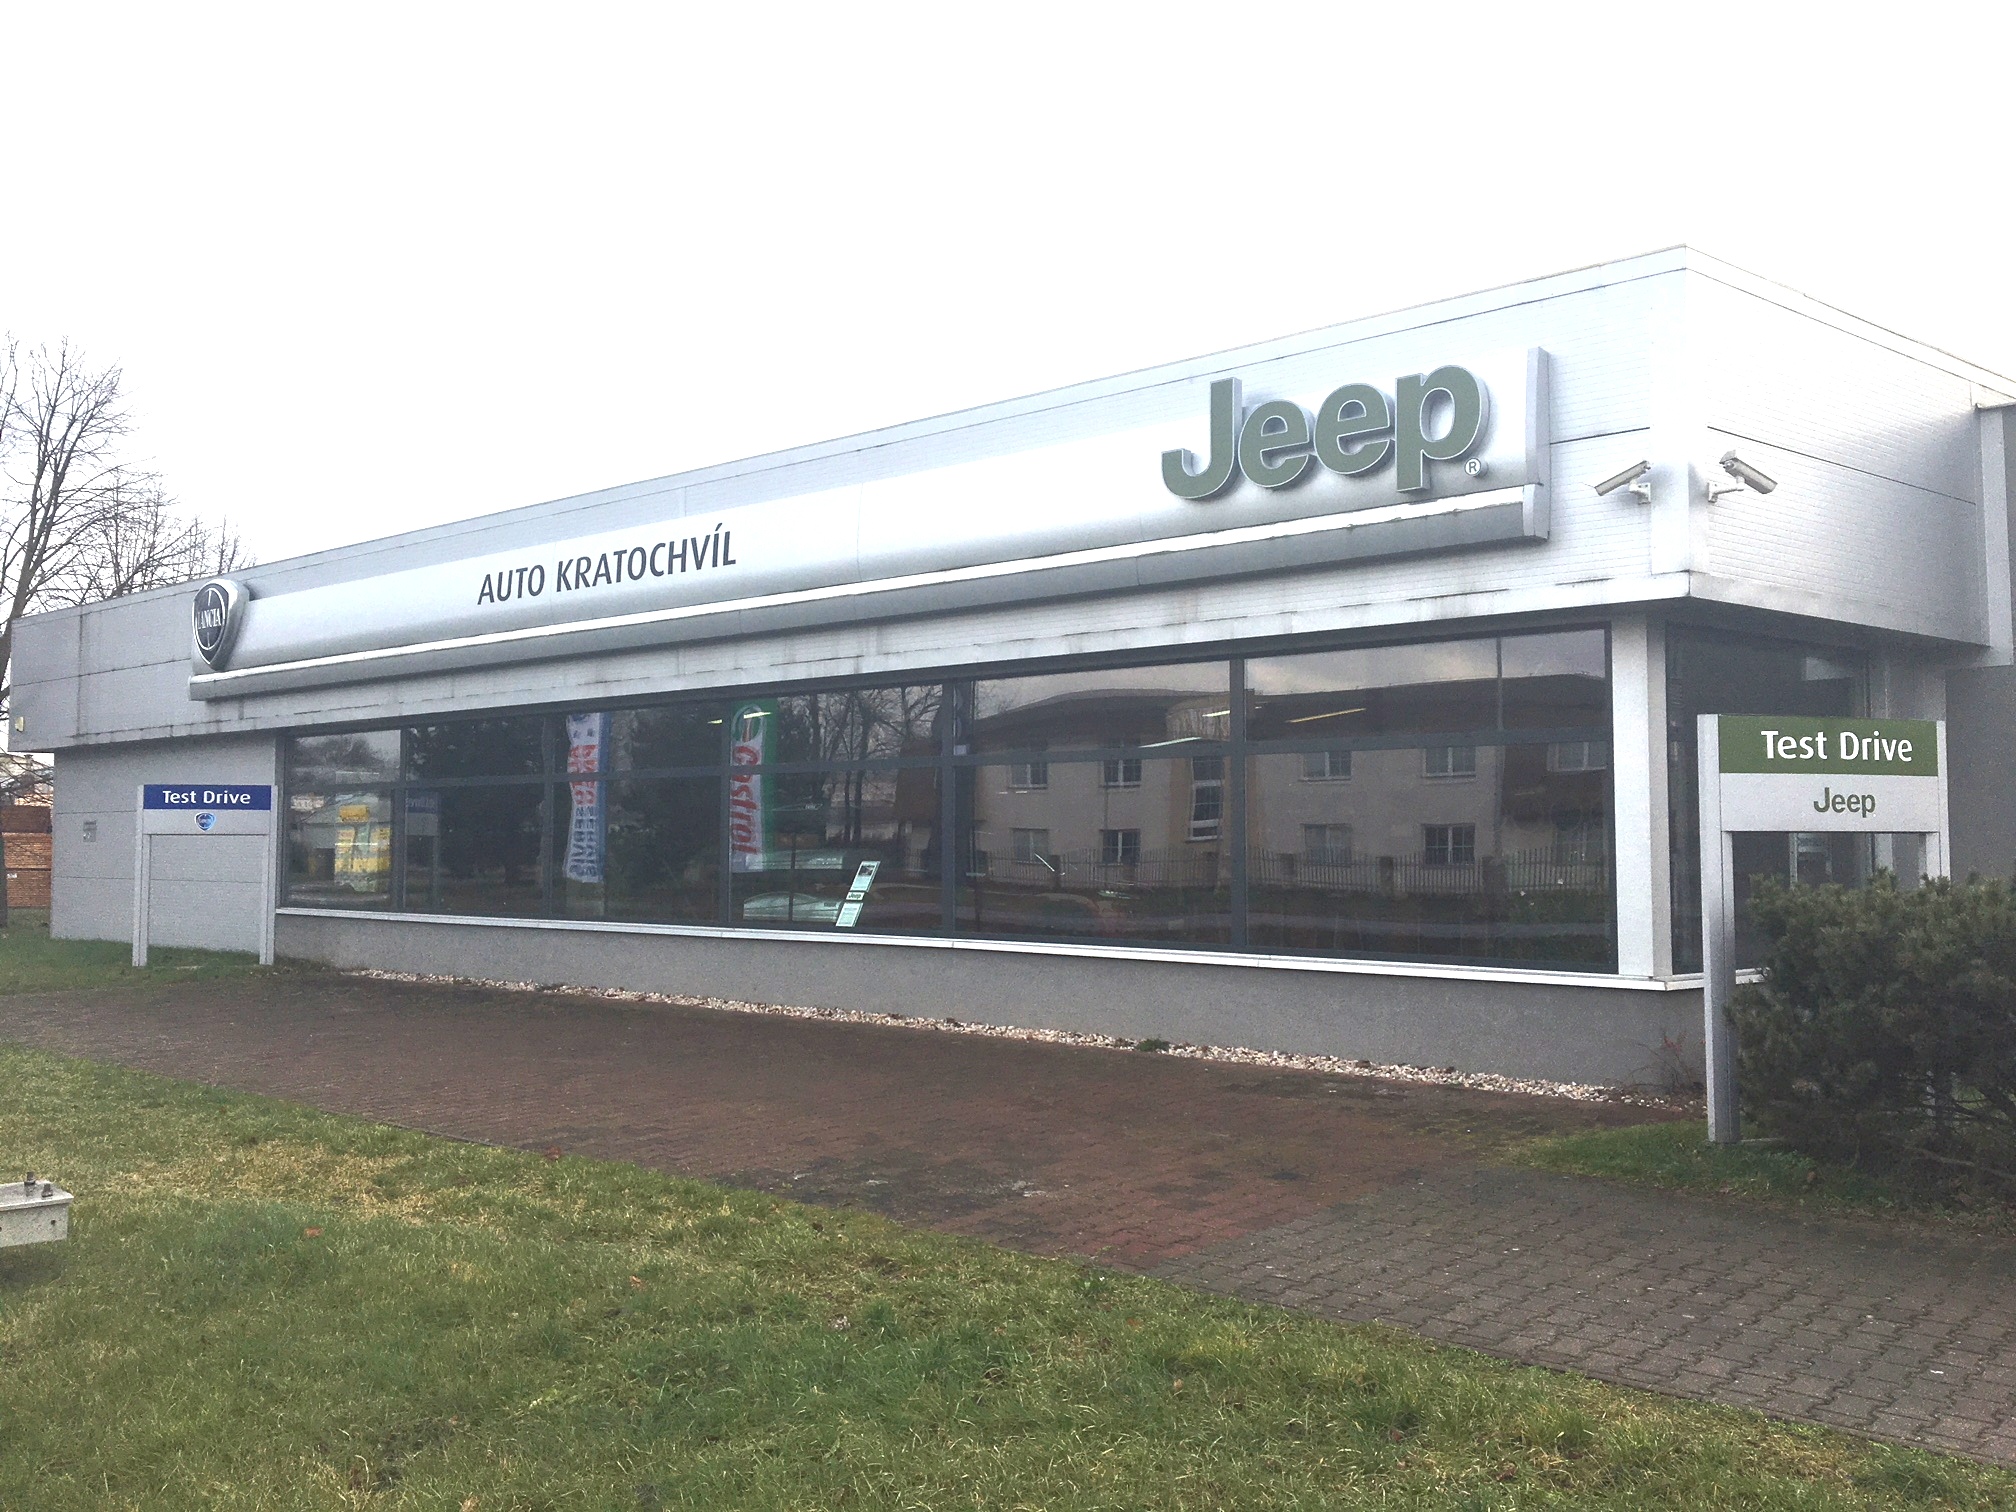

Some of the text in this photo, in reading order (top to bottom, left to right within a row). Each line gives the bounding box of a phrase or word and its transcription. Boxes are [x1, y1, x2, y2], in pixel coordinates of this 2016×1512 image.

[1161, 364, 1488, 500] Jeep
[477, 522, 737, 605] AUTO KRATOCHVÍL
[197, 608, 222, 630] LANCIA
[1760, 730, 1913, 762] Test Drive
[162, 790, 251, 804] Test Drive
[1813, 787, 1876, 818] Jeep
